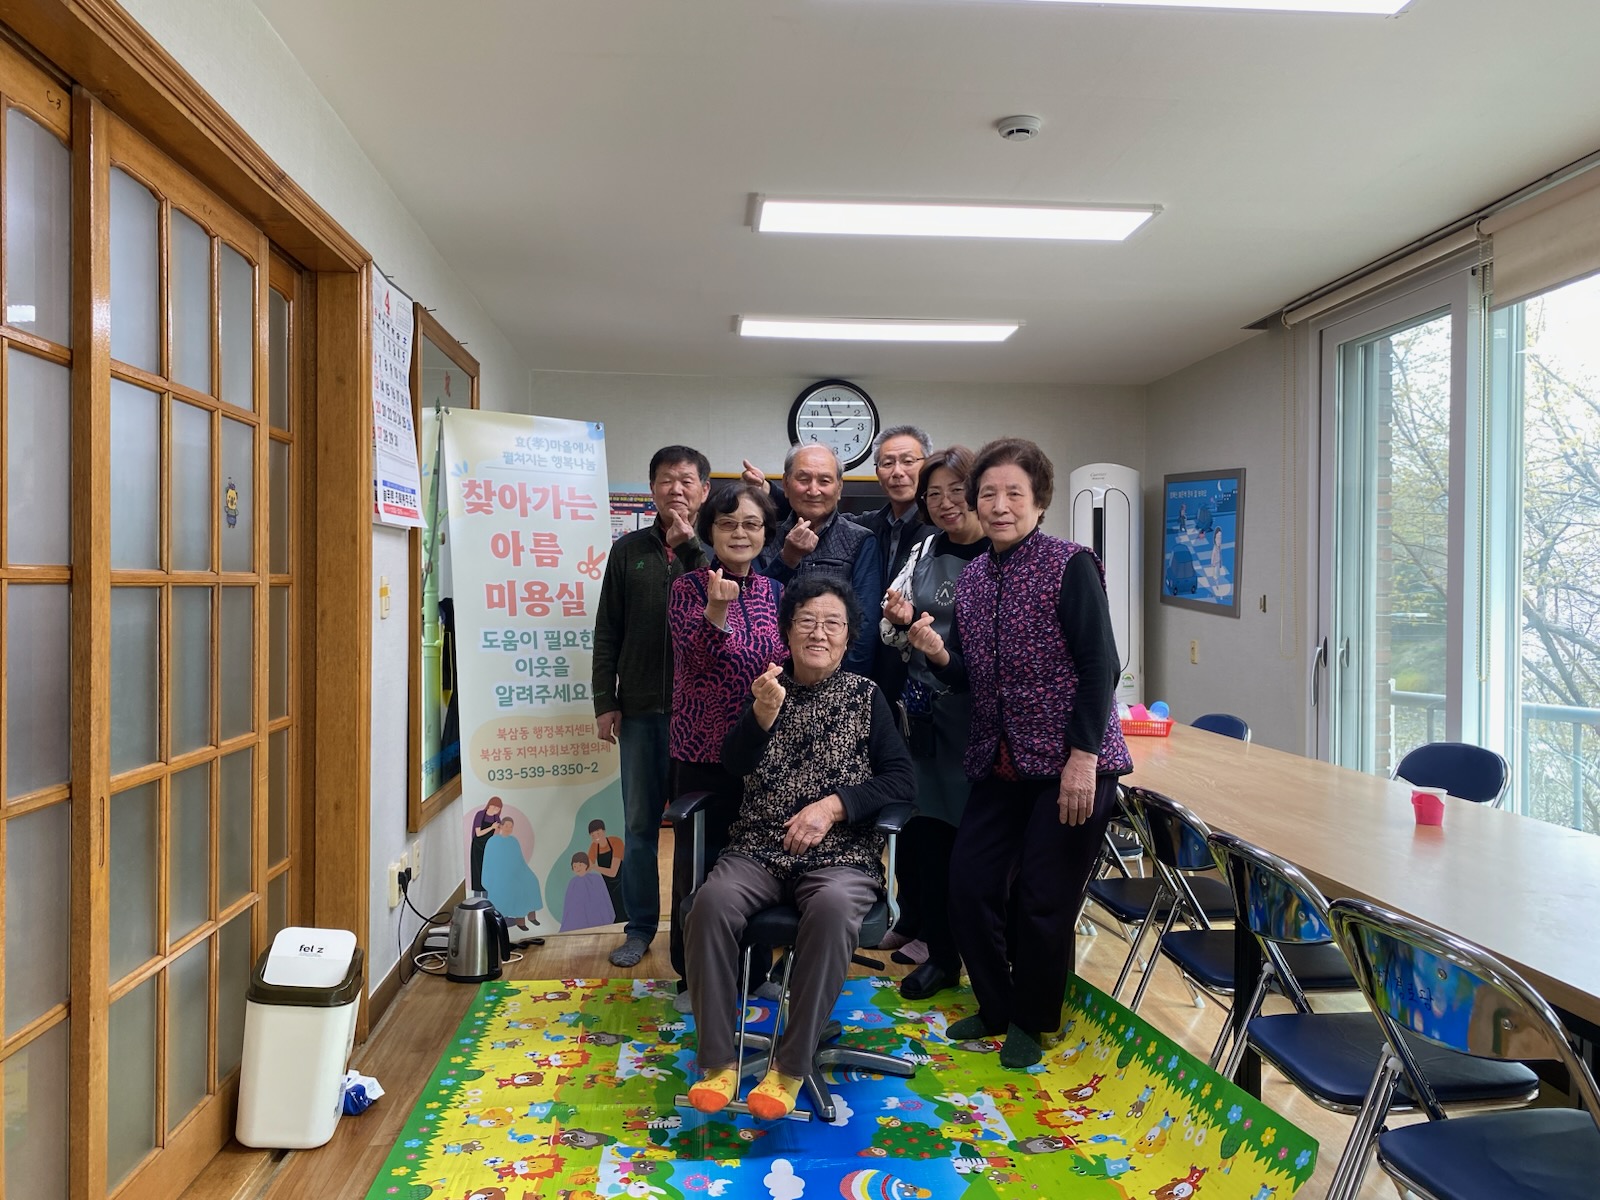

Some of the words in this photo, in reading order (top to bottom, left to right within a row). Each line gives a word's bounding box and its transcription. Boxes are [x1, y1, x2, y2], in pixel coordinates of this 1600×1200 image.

[385, 289, 390, 316] 4
[854, 409, 861, 417] 2
[857, 423, 865, 431] 3
[515, 436, 595, 454] 효(孝)마을에서
[810, 433, 818, 442] 8
[844, 443, 851, 452] 5
[853, 434, 860, 443] 4
[502, 452, 548, 468] 펼쳐지는
[551, 455, 596, 472] 행복나눔
[462, 479, 598, 521] 찾아가는
[490, 531, 564, 568] 아름
[485, 580, 588, 617] 미용실
[482, 630, 538, 651] 도움이
[544, 629, 594, 651] 필요한
[515, 656, 570, 678] 이웃을
[496, 726, 529, 741] 북삼동
[533, 723, 595, 740] 행정복지센터
[480, 746, 513, 762] 북삼동
[516, 740, 611, 759] 지역사회보장협의체
[487, 761, 599, 782] 033-539-8350~2
